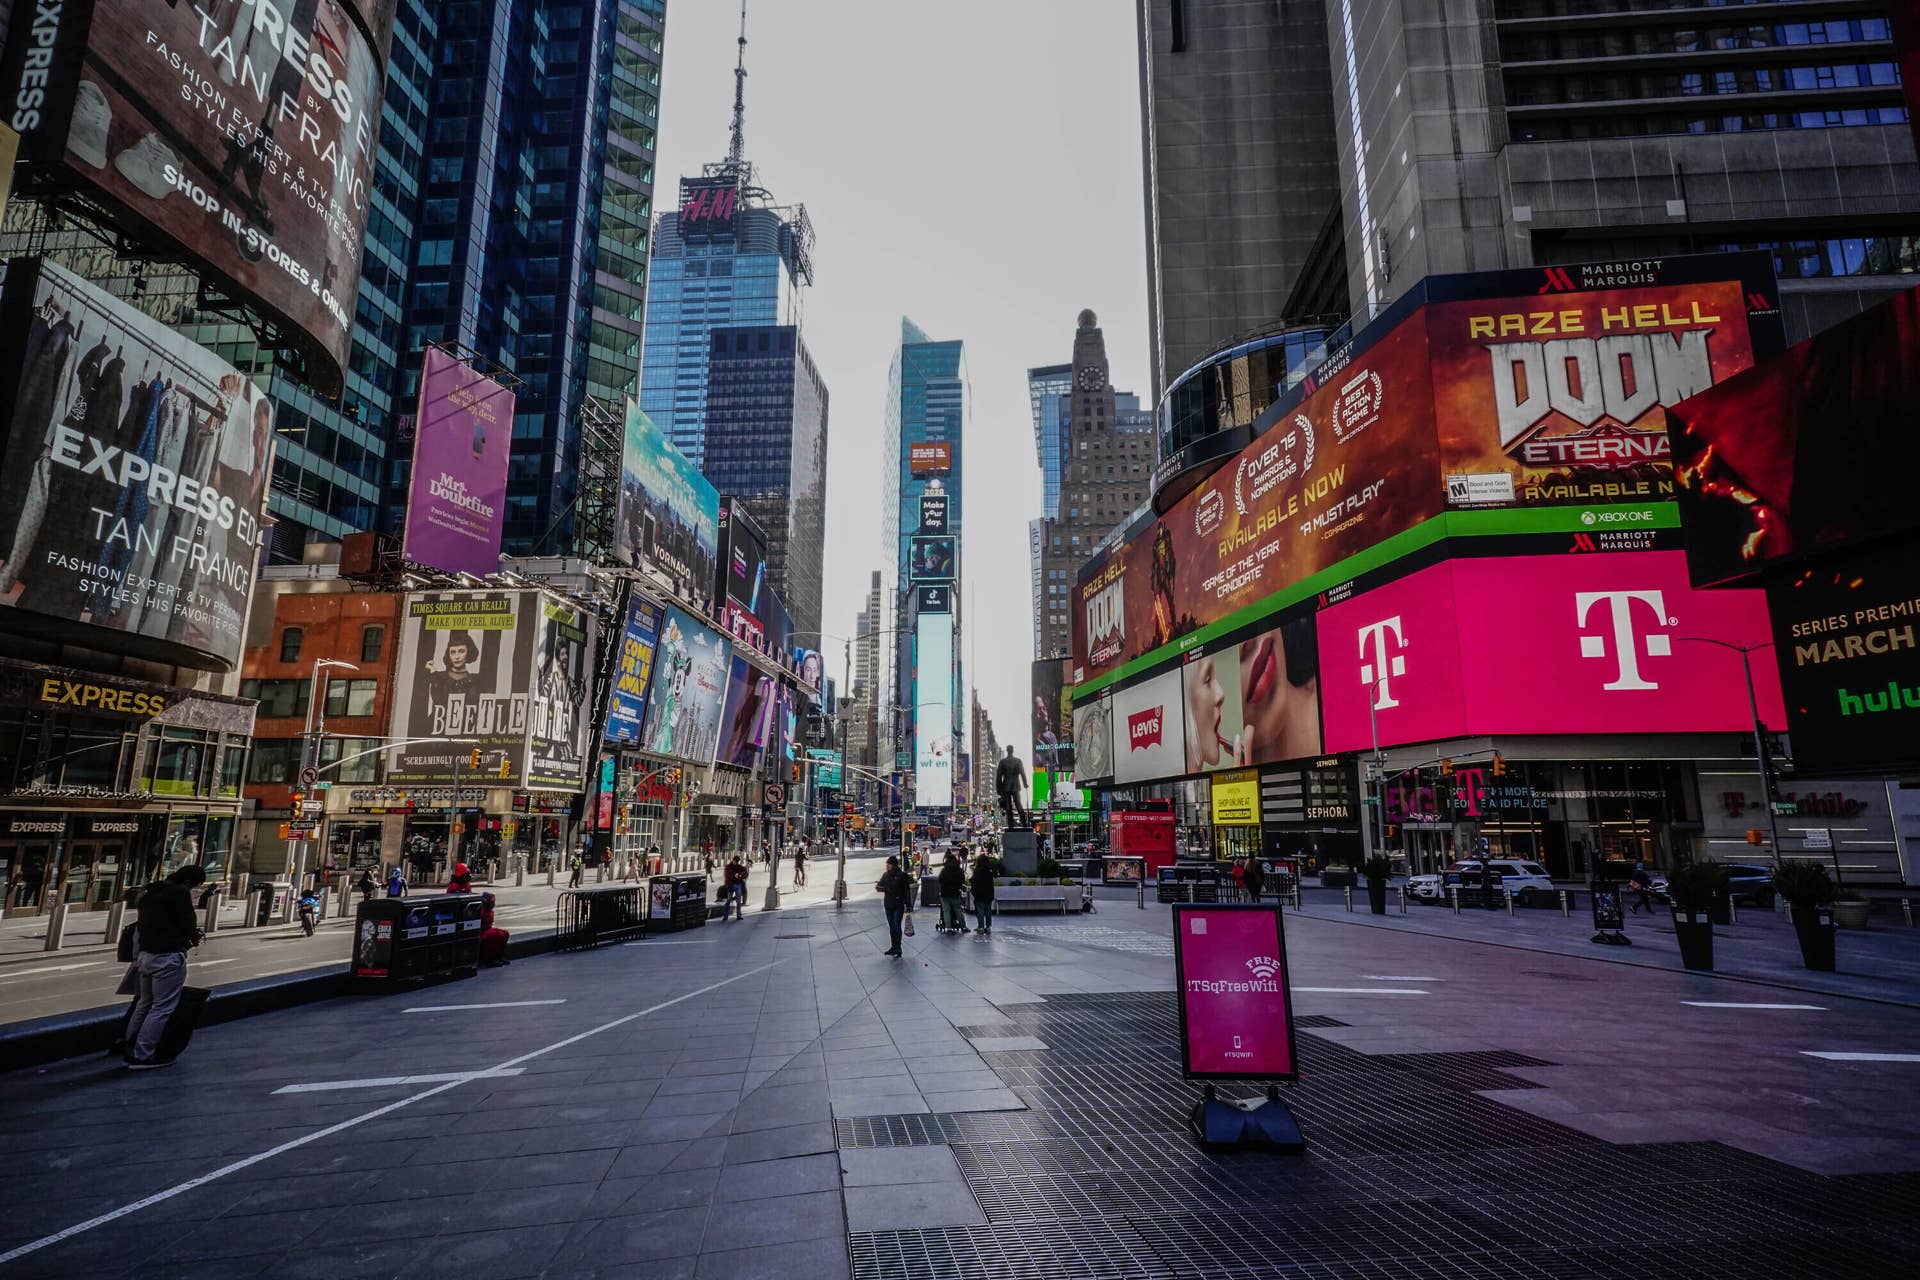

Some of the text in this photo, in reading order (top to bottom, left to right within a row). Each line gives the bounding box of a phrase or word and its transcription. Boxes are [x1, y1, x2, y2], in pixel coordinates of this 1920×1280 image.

[12, 0, 62, 132] XPRESS
[194, 4, 267, 104] TAN
[229, 0, 353, 124] RESS
[146, 30, 328, 200] FASHION EXPERT & TV
[307, 95, 322, 113] BY
[181, 84, 340, 235] STYLES HIS FAVORITE
[680, 186, 738, 223] H&M
[162, 164, 351, 333] SHOP IN-STORES & ONLINE
[1582, 260, 1664, 277] MARRIOTT
[1584, 273, 1656, 288] MARQUIS
[1470, 300, 1722, 340] RAZE HELL
[1318, 344, 1354, 376] MARRIOTT
[1318, 355, 1351, 386] MARQUIS
[1345, 384, 1367, 407] BEST
[1480, 328, 1716, 456] DOOM
[1342, 392, 1372, 420] ACTION
[1346, 406, 1370, 428] GAME
[1157, 450, 1185, 474] MARRIOTT
[1248, 430, 1297, 478] OVER 75
[51, 424, 236, 530] EXPRESS
[440, 472, 468, 492] Mrs.
[1157, 462, 1182, 482] MARQUIS
[1250, 462, 1298, 502] NOMINATIONS
[1254, 460, 1286, 488] AWARDS
[429, 479, 494, 518] Doubtfire
[924, 488, 945, 497] 2020
[1450, 482, 1467, 498] M
[1525, 482, 1651, 501] AVAILABLE
[923, 501, 945, 510] Make
[925, 510, 943, 519] your
[1218, 463, 1346, 560] AVAILABLE NOW
[1313, 500, 1345, 528] MUST
[1598, 511, 1654, 523] XBOX ONE
[196, 526, 208, 537] BY
[926, 518, 942, 528] day.
[1600, 531, 1657, 541] MARRIOTT
[91, 507, 249, 597] TAN FRANCE
[1601, 540, 1652, 550] MARQUIS
[654, 543, 690, 580] VORNADO
[1225, 567, 1238, 580] OF
[1238, 557, 1255, 573] THE
[1255, 540, 1281, 563] YEAR
[47, 551, 212, 609] FASHION EXPERT & TV
[1083, 559, 1127, 600] RAZE HELL
[1328, 580, 1354, 597] MARRIOTT
[79, 578, 140, 605] STYLES
[146, 596, 169, 612] HIS
[174, 603, 221, 629] FAVORITE
[412, 600, 508, 614] TIMES SQUARE CAN REALLY
[1328, 590, 1352, 605] MARQUIS
[429, 615, 513, 627] MAKE YOU FEEL ALIVE!
[1086, 576, 1126, 662] DOOM
[1792, 614, 1849, 639] SERIES
[624, 638, 653, 666] COME
[1091, 641, 1123, 667] ETERNAL
[1795, 625, 1916, 666] MARCH
[620, 654, 651, 681] FROM
[41, 678, 165, 716] EXPRESS
[617, 671, 649, 697] AWAY
[1838, 681, 1920, 716] hulu
[431, 695, 527, 736] BEETLE
[531, 695, 570, 744] JUICE
[1316, 759, 1338, 768] SEPHORA
[1218, 798, 1231, 808] SHOP
[1456, 768, 1484, 817] T
[1307, 806, 1348, 818] SEPHORA
[9, 821, 66, 833] EXPRESS
[91, 821, 139, 833] EXPRESS
[1245, 956, 1280, 969] FREE
[1188, 979, 1279, 994] !TSqFreeWifi
[1224, 1051, 1254, 1059] #TSQWIFI
